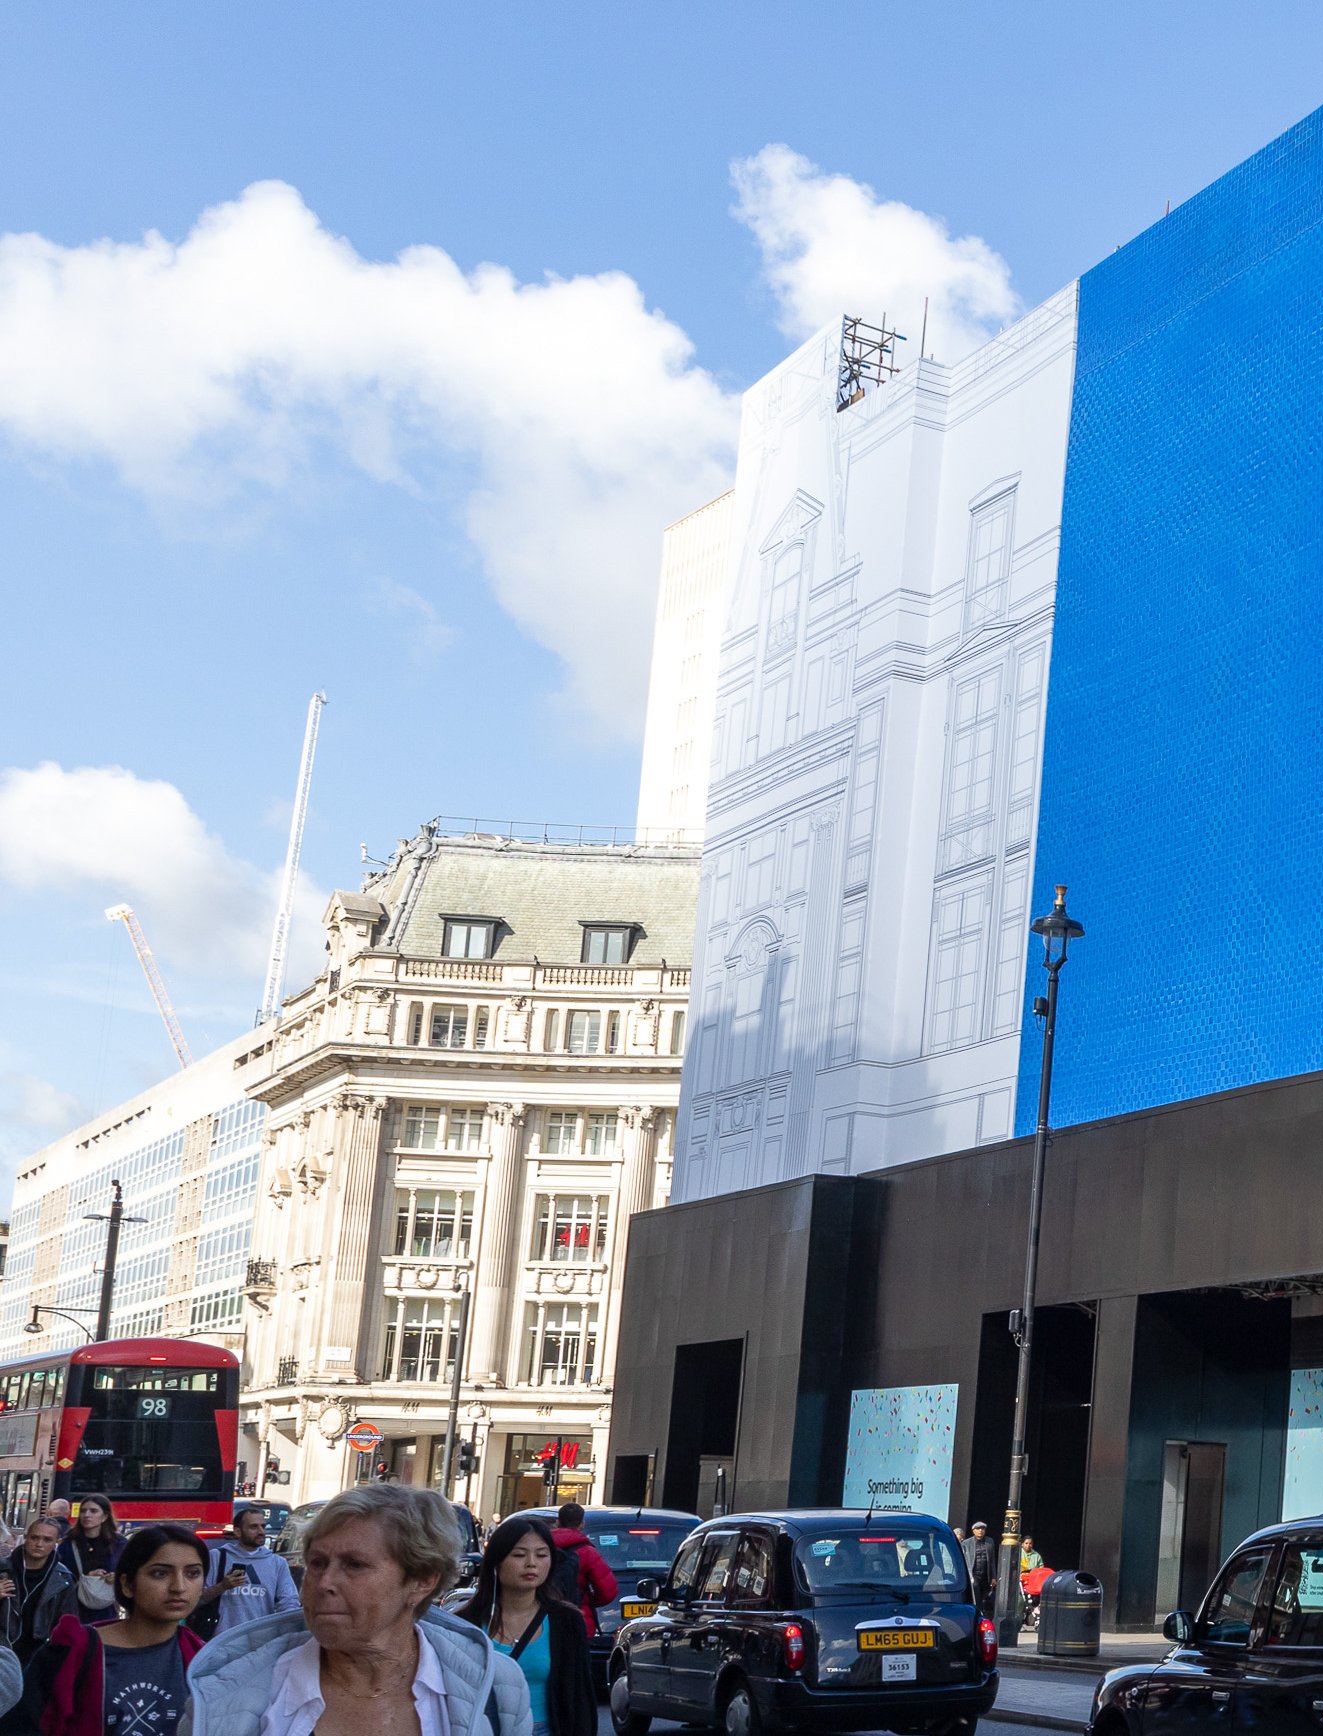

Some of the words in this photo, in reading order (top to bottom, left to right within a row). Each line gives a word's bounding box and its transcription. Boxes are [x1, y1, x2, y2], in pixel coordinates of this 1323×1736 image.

[142, 1399, 167, 1416] 98
[536, 1441, 579, 1469] HM
[867, 1478, 909, 1499] Something
[911, 1478, 924, 1499] big
[866, 1634, 899, 1646] LM65
[903, 1633, 927, 1645] GUJ
[112, 1682, 172, 1704] MATHWORKS
